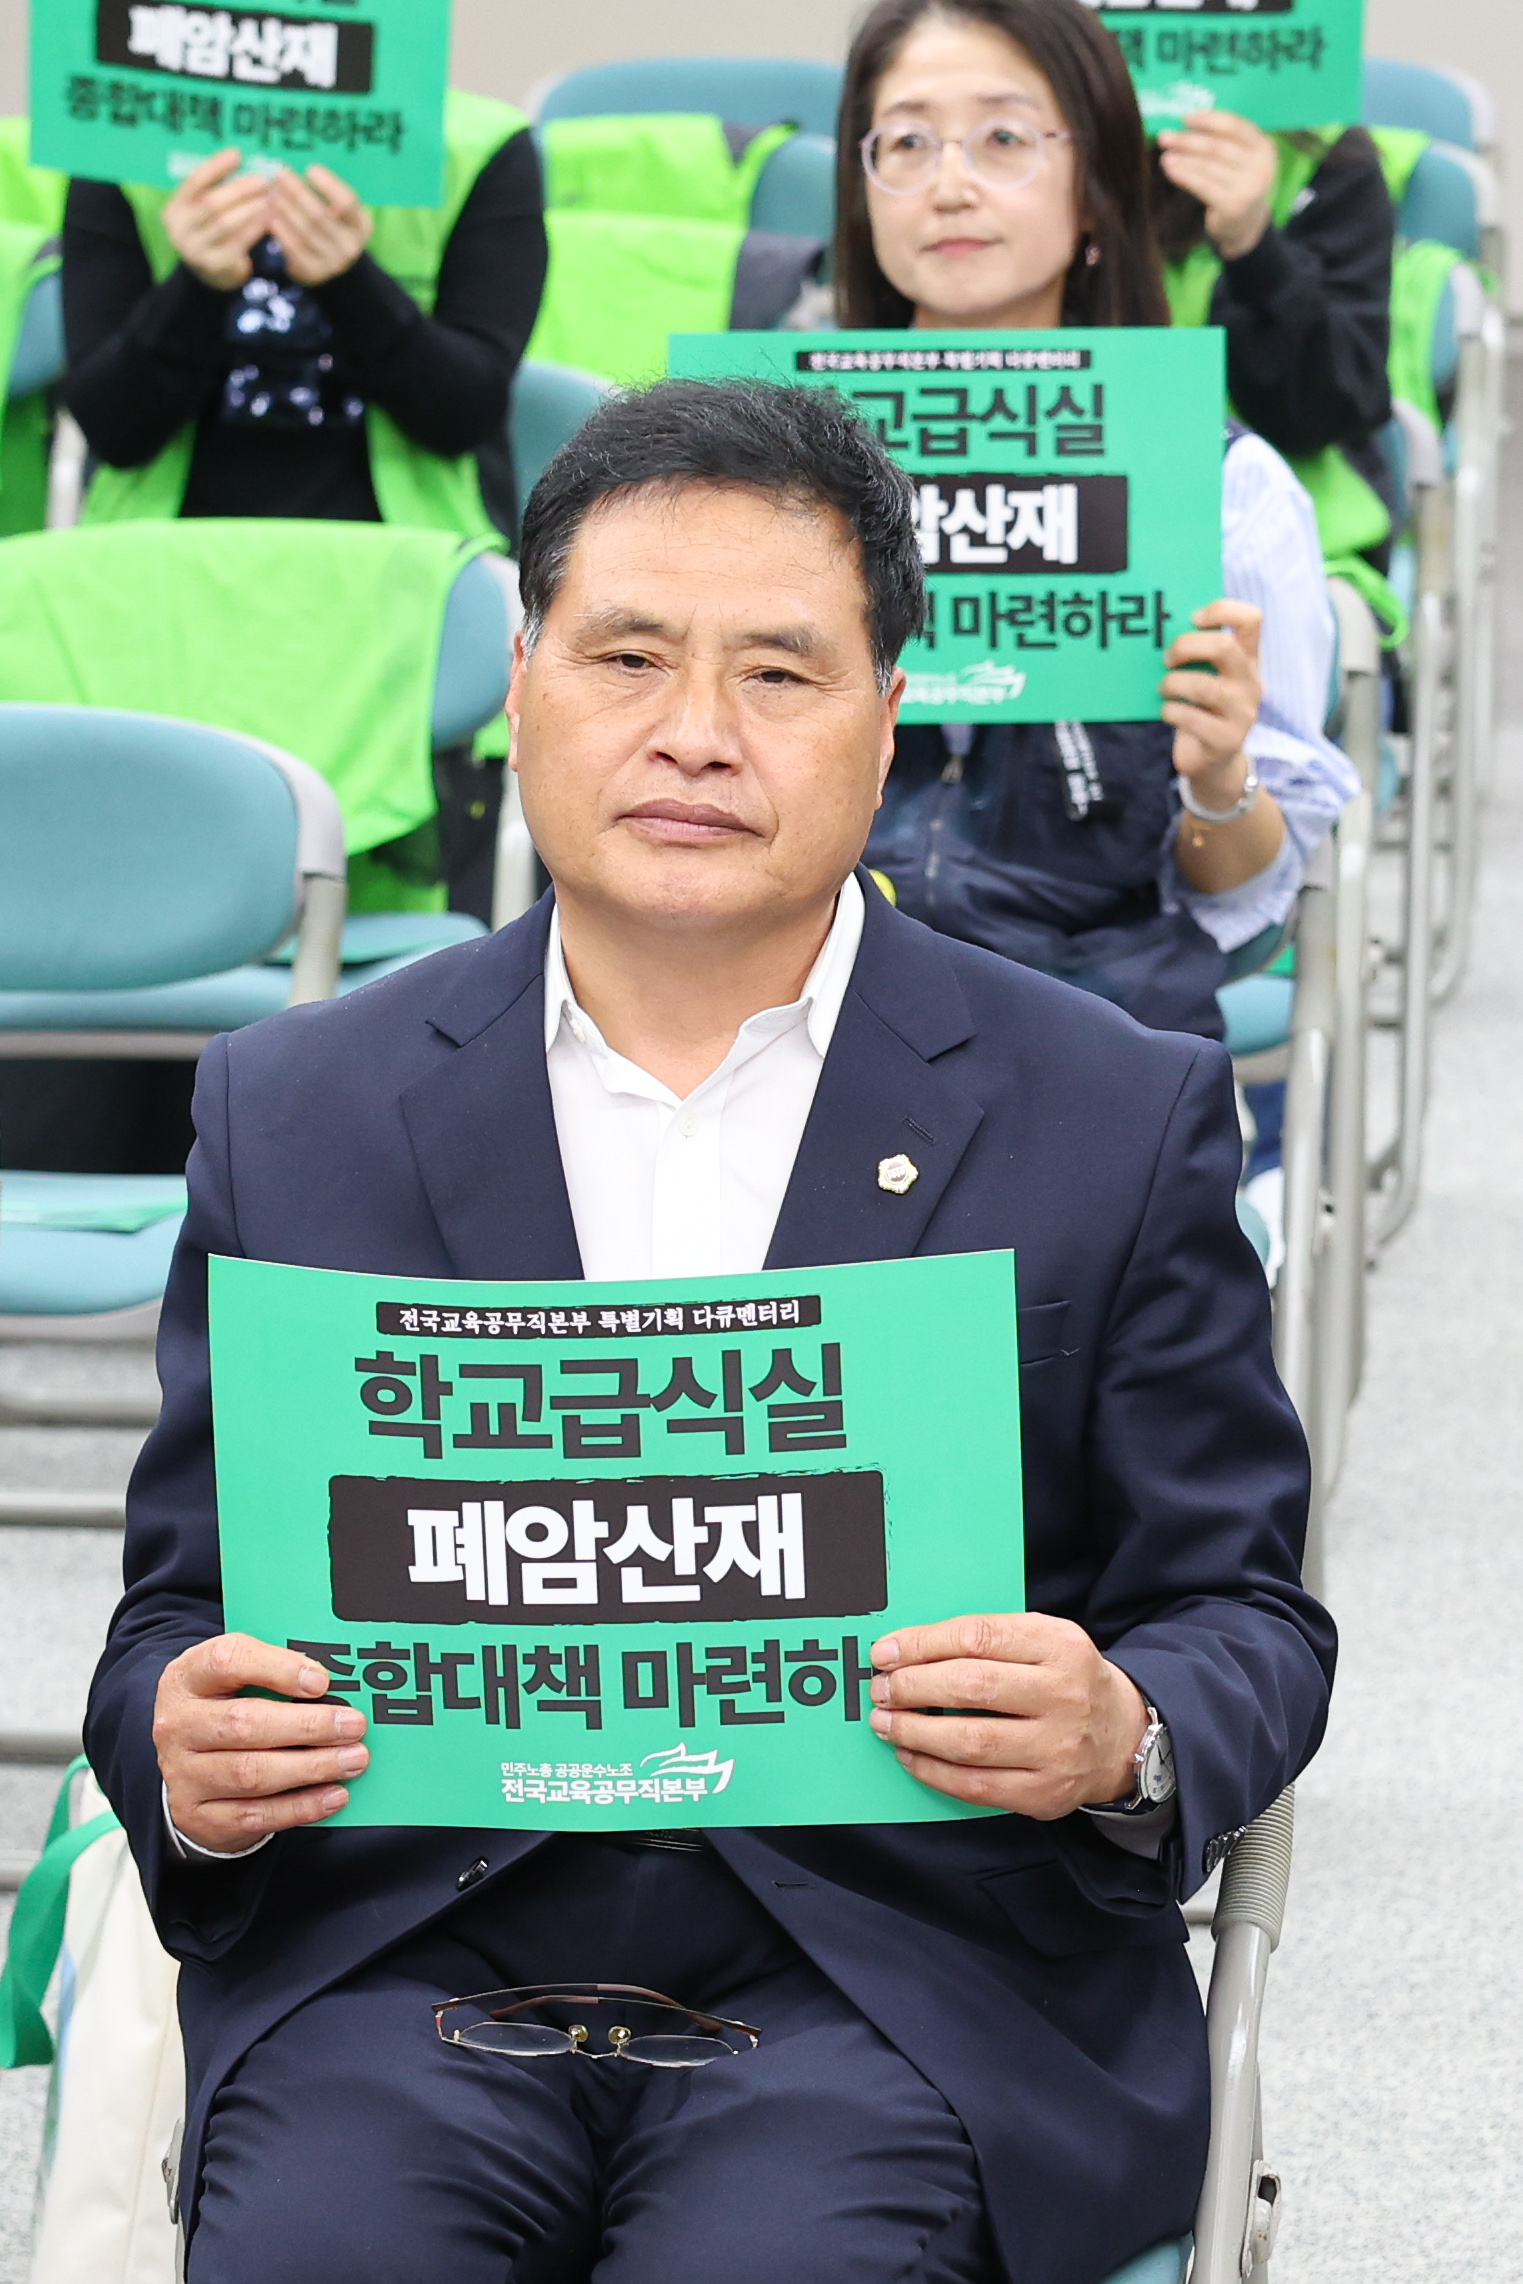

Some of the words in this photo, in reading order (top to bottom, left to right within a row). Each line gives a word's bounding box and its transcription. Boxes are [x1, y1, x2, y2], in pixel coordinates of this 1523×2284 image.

[851, 384, 1105, 457] 교급식실
[953, 591, 1171, 649] 마련하라
[400, 1308, 591, 1334] 전국교육공무직본부
[598, 1304, 684, 1333] 특별기획
[693, 1300, 800, 1331] 다큐멘터리
[355, 1343, 847, 1459] 학교급식실
[407, 1493, 806, 1606] 폐암산재
[622, 1636, 892, 1728] 마련하
[501, 1762, 552, 1779] 민주노총
[555, 1762, 633, 1779] 공공운수노조
[501, 1778, 708, 1804] 전국교육공무직본부
